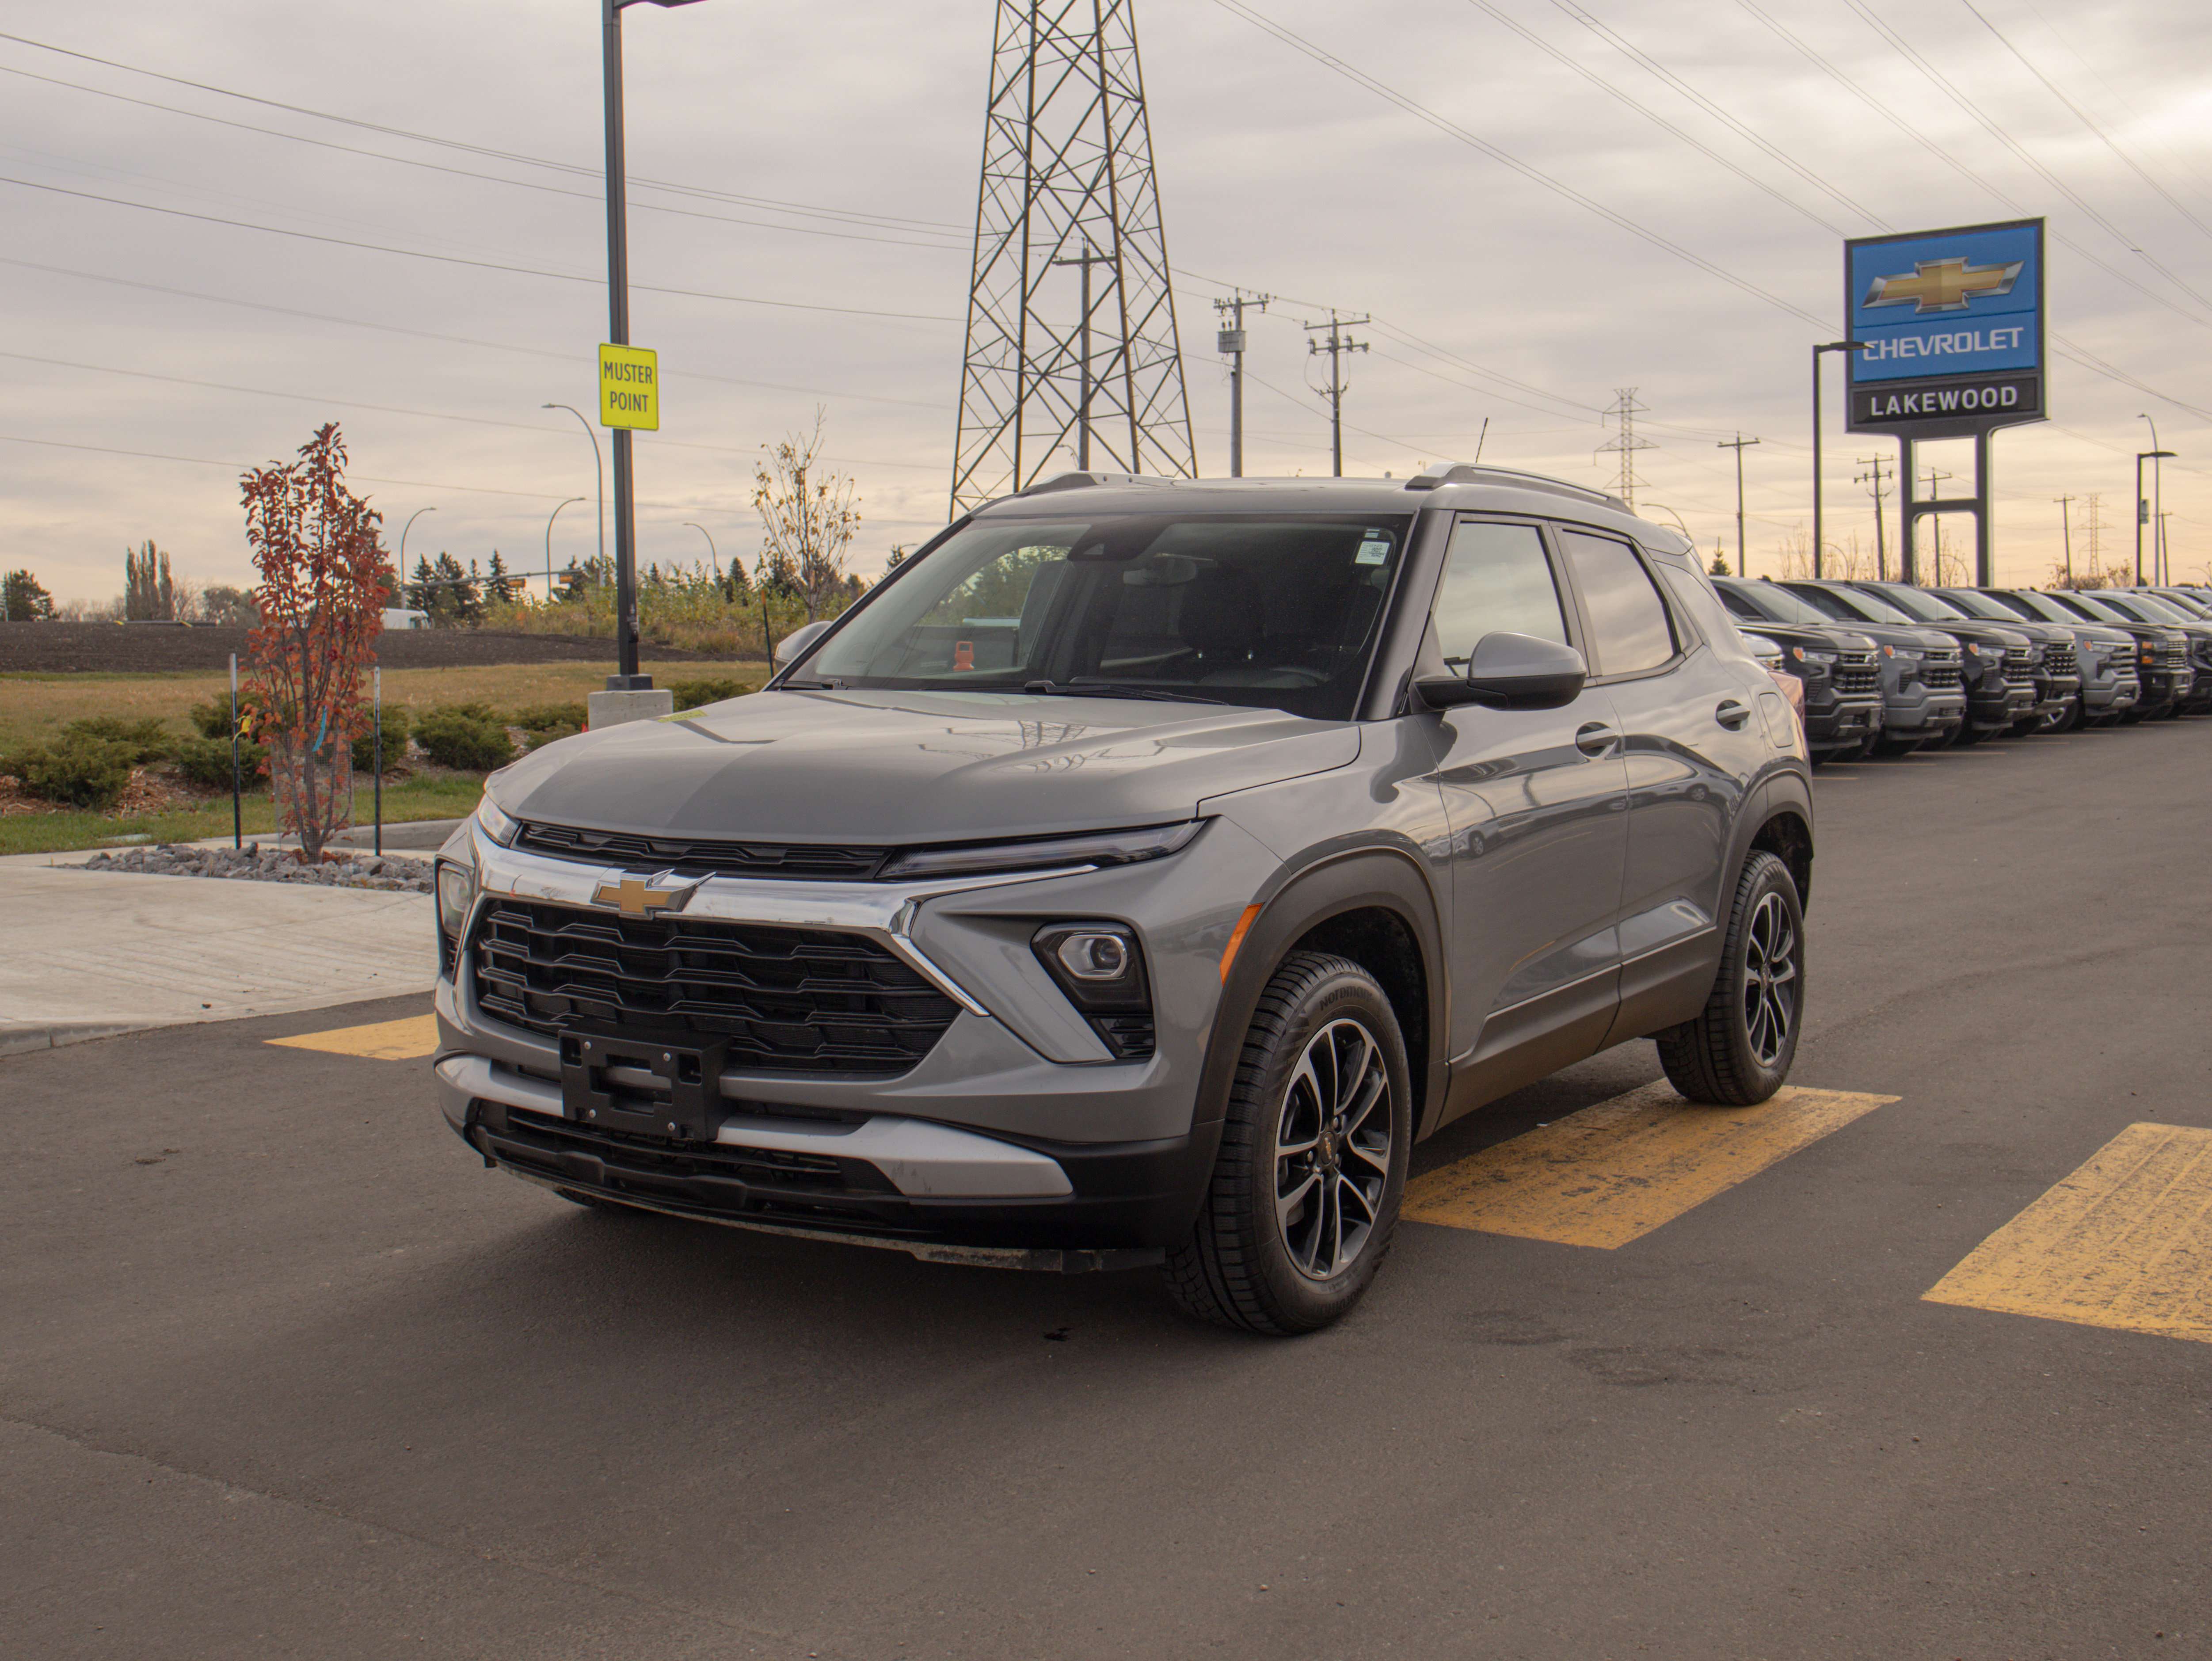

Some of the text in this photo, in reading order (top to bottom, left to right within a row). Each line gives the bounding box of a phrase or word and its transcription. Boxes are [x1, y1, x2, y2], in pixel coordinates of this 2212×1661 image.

[1863, 327, 2024, 361] CHEVROLET
[604, 361, 652, 384] MUSTER
[610, 391, 648, 412] POINT
[1871, 386, 2018, 416] LAKEWOOD
